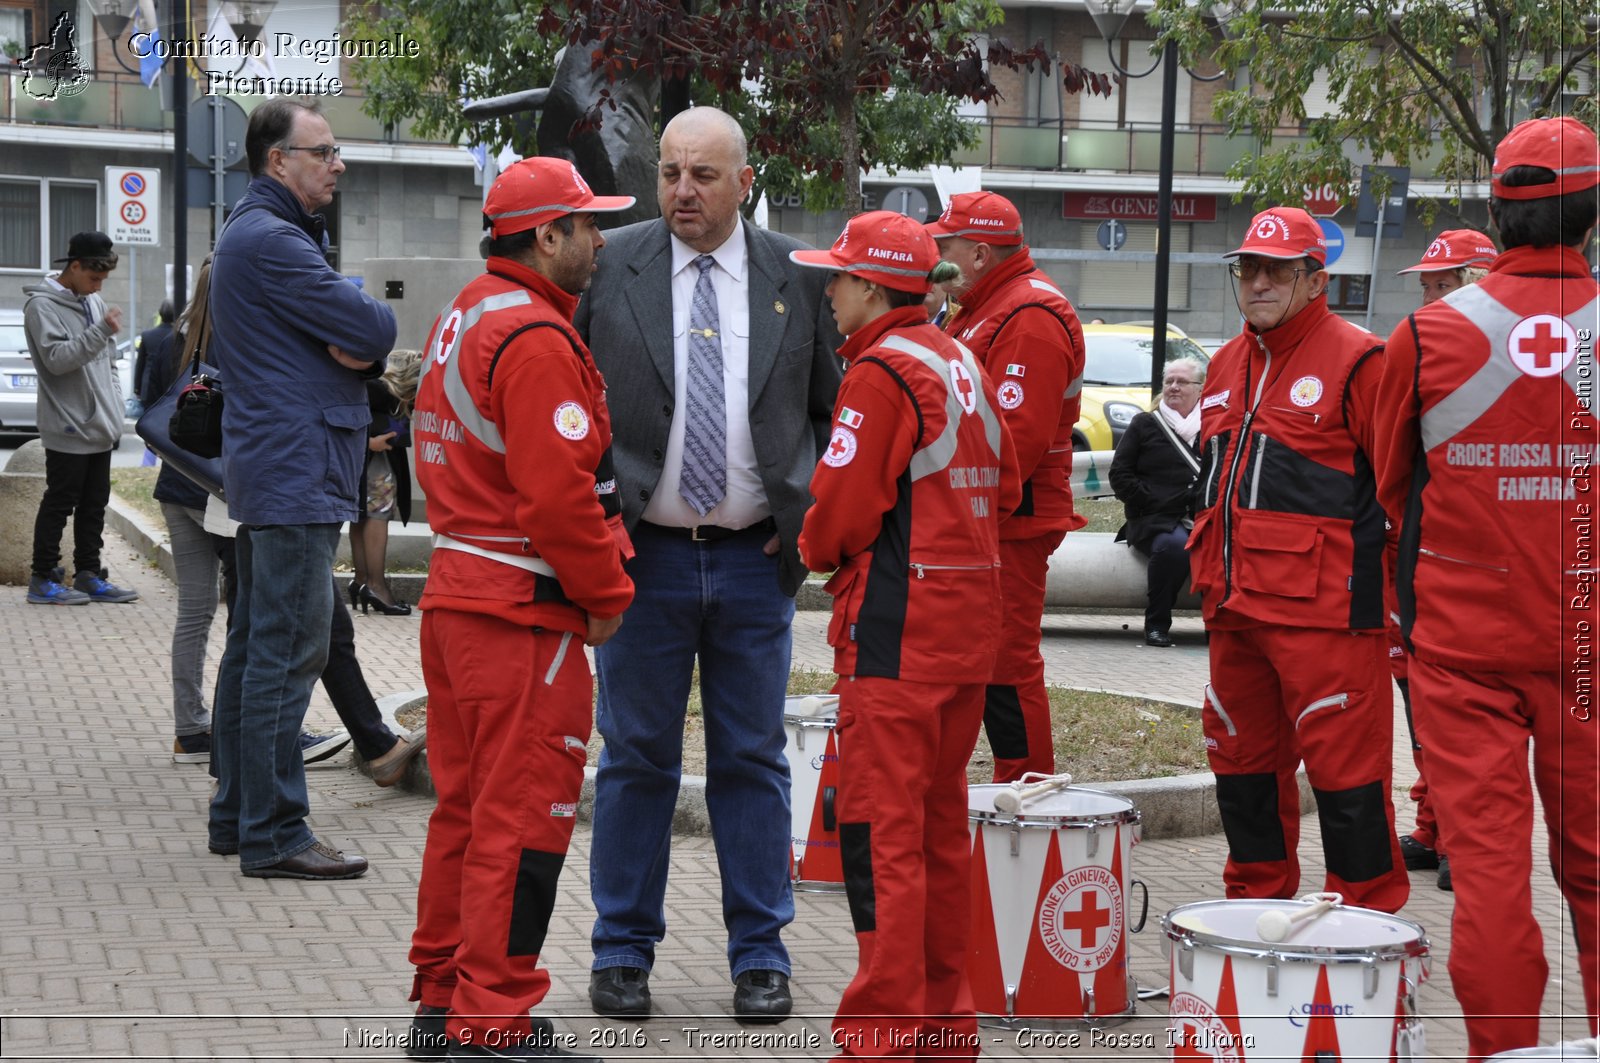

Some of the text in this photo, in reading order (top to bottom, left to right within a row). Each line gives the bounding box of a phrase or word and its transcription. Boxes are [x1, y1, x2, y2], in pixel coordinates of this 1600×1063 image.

[1111, 199, 1196, 216] GENEALI
[969, 218, 1004, 227] FANFARA
[868, 247, 913, 262] FANFARA
[1447, 443, 1495, 467] CROCE
[1500, 443, 1552, 467] ROSSA
[1498, 477, 1577, 501] FANFARA
[1042, 869, 1122, 968] CONVENZIONE DI GINEVRA 22 AGOSTO 1864
[1301, 1003, 1354, 1016] amat
